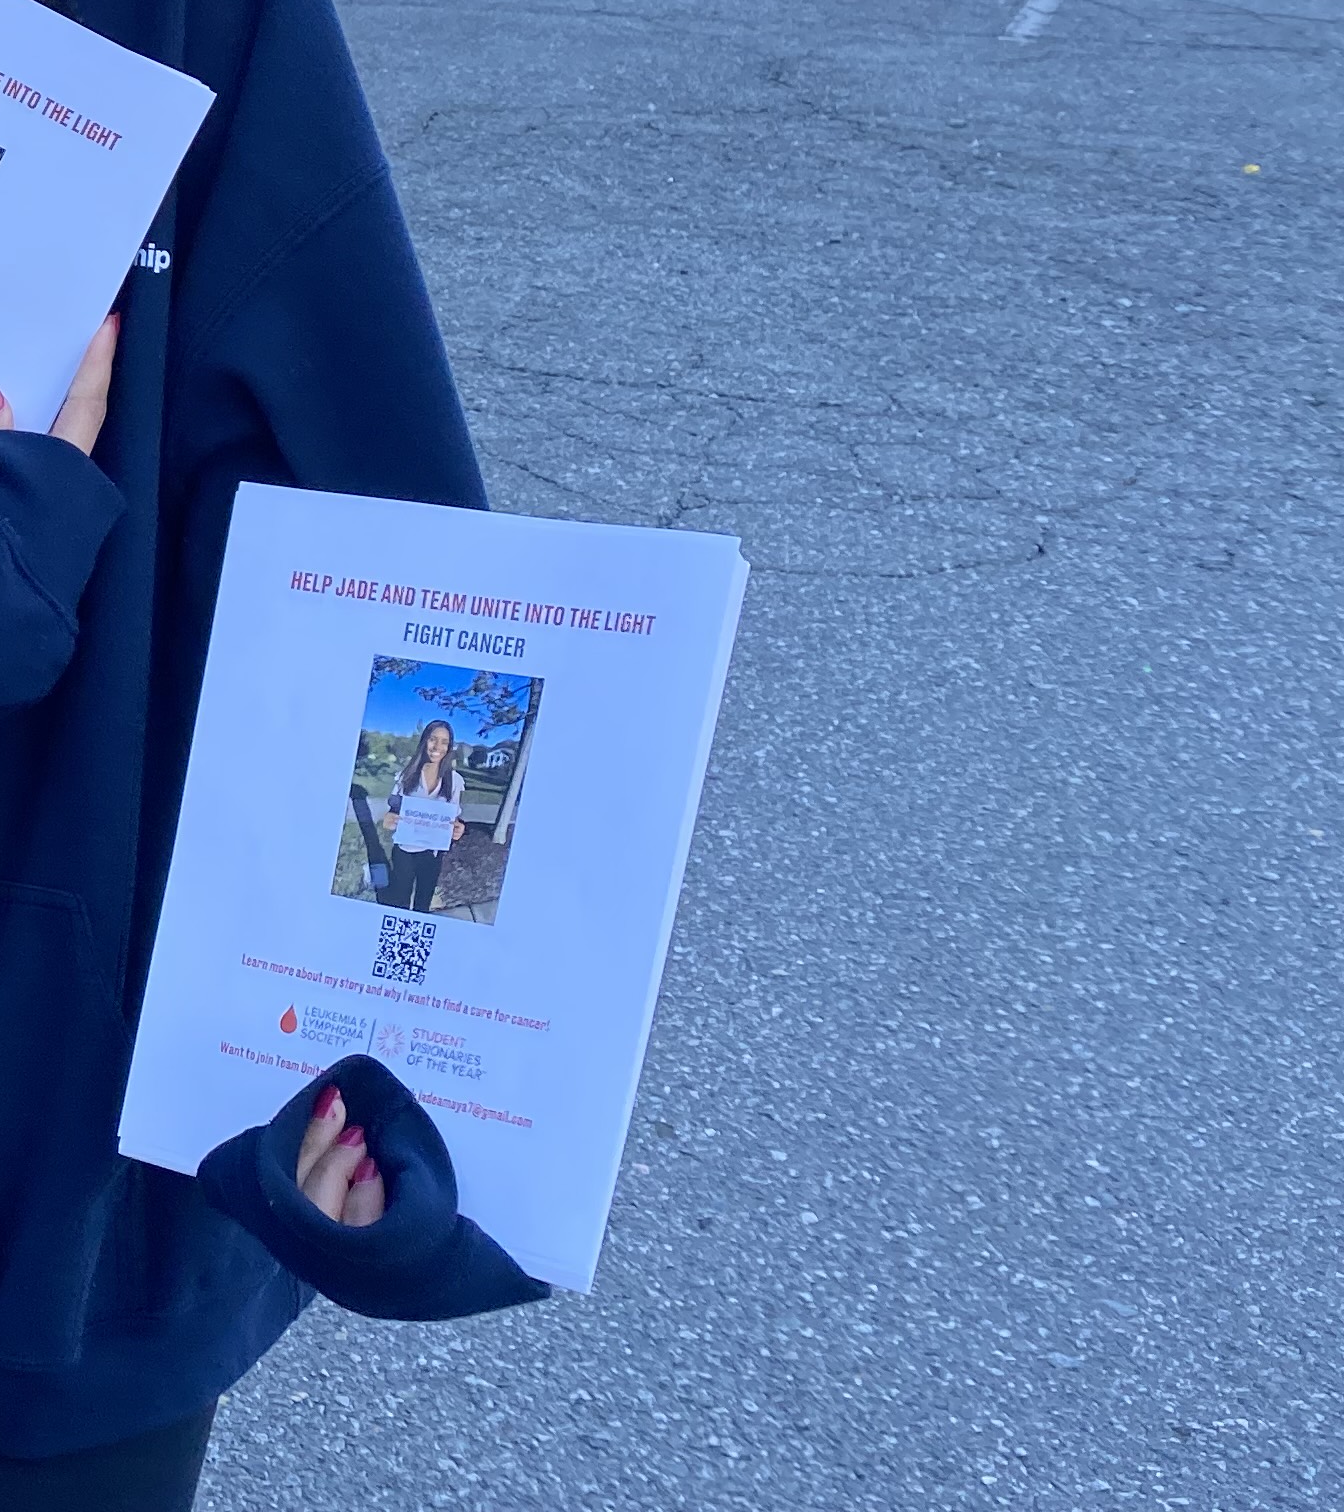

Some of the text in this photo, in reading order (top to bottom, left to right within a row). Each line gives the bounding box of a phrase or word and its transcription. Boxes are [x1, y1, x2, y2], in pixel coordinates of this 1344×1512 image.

[2, 77, 42, 109] INTO
[42, 97, 74, 127] THE
[71, 114, 122, 151] LIGHT
[290, 570, 657, 636] HELP JADE AND TEAM UNITE INTO THE LIGHT
[403, 622, 526, 658] FIGHT CANCER
[241, 953, 268, 969] Learn
[269, 962, 295, 977] more
[295, 966, 323, 983] about
[324, 975, 339, 989] my
[339, 977, 366, 994] story
[365, 983, 383, 996] and
[384, 987, 402, 1002] why
[408, 994, 431, 1007] want
[431, 996, 441, 1009] to
[443, 998, 463, 1013] find
[470, 1006, 493, 1020] cure
[494, 1008, 511, 1023] for
[511, 1016, 551, 1032] cancer!
[302, 1017, 364, 1040] LYMPHOMA
[305, 1005, 357, 1026] LEUKEMIA
[300, 1029, 349, 1048] SOCIETY
[412, 1027, 466, 1049] STUDENT
[220, 1040, 244, 1058] Want
[245, 1047, 255, 1061] to
[255, 1052, 274, 1065] join
[275, 1054, 300, 1071] Team
[406, 1054, 424, 1066] OF
[426, 1058, 447, 1073] THE
[410, 1040, 481, 1067] VISIONARIES
